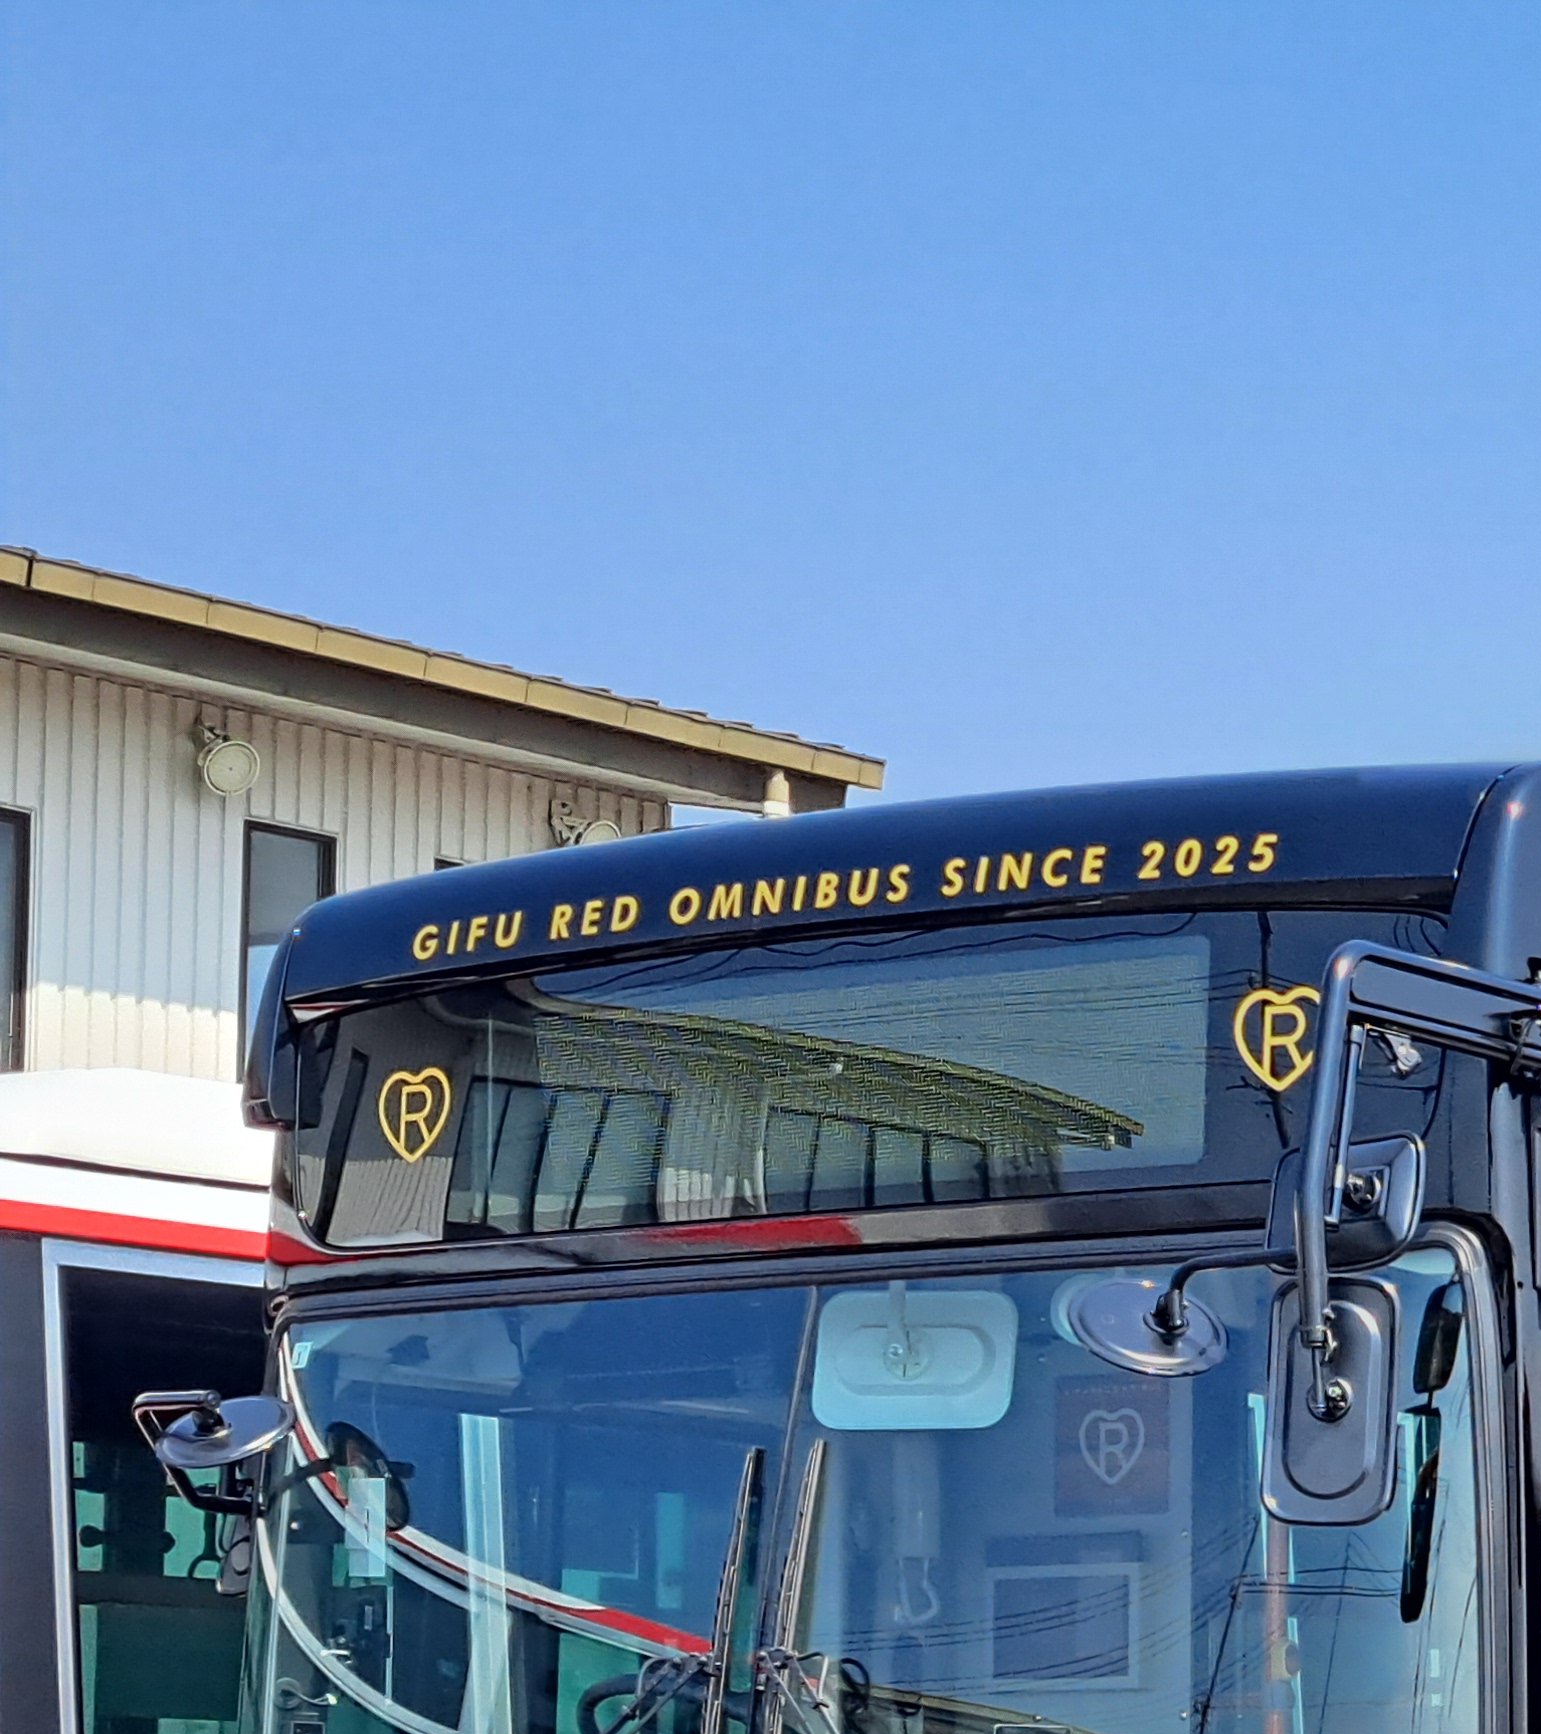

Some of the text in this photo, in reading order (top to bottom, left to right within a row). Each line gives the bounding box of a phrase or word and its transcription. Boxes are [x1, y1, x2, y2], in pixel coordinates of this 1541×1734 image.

[412, 832, 1280, 963] GIFU RED OMNIBUS SINCE 2025
